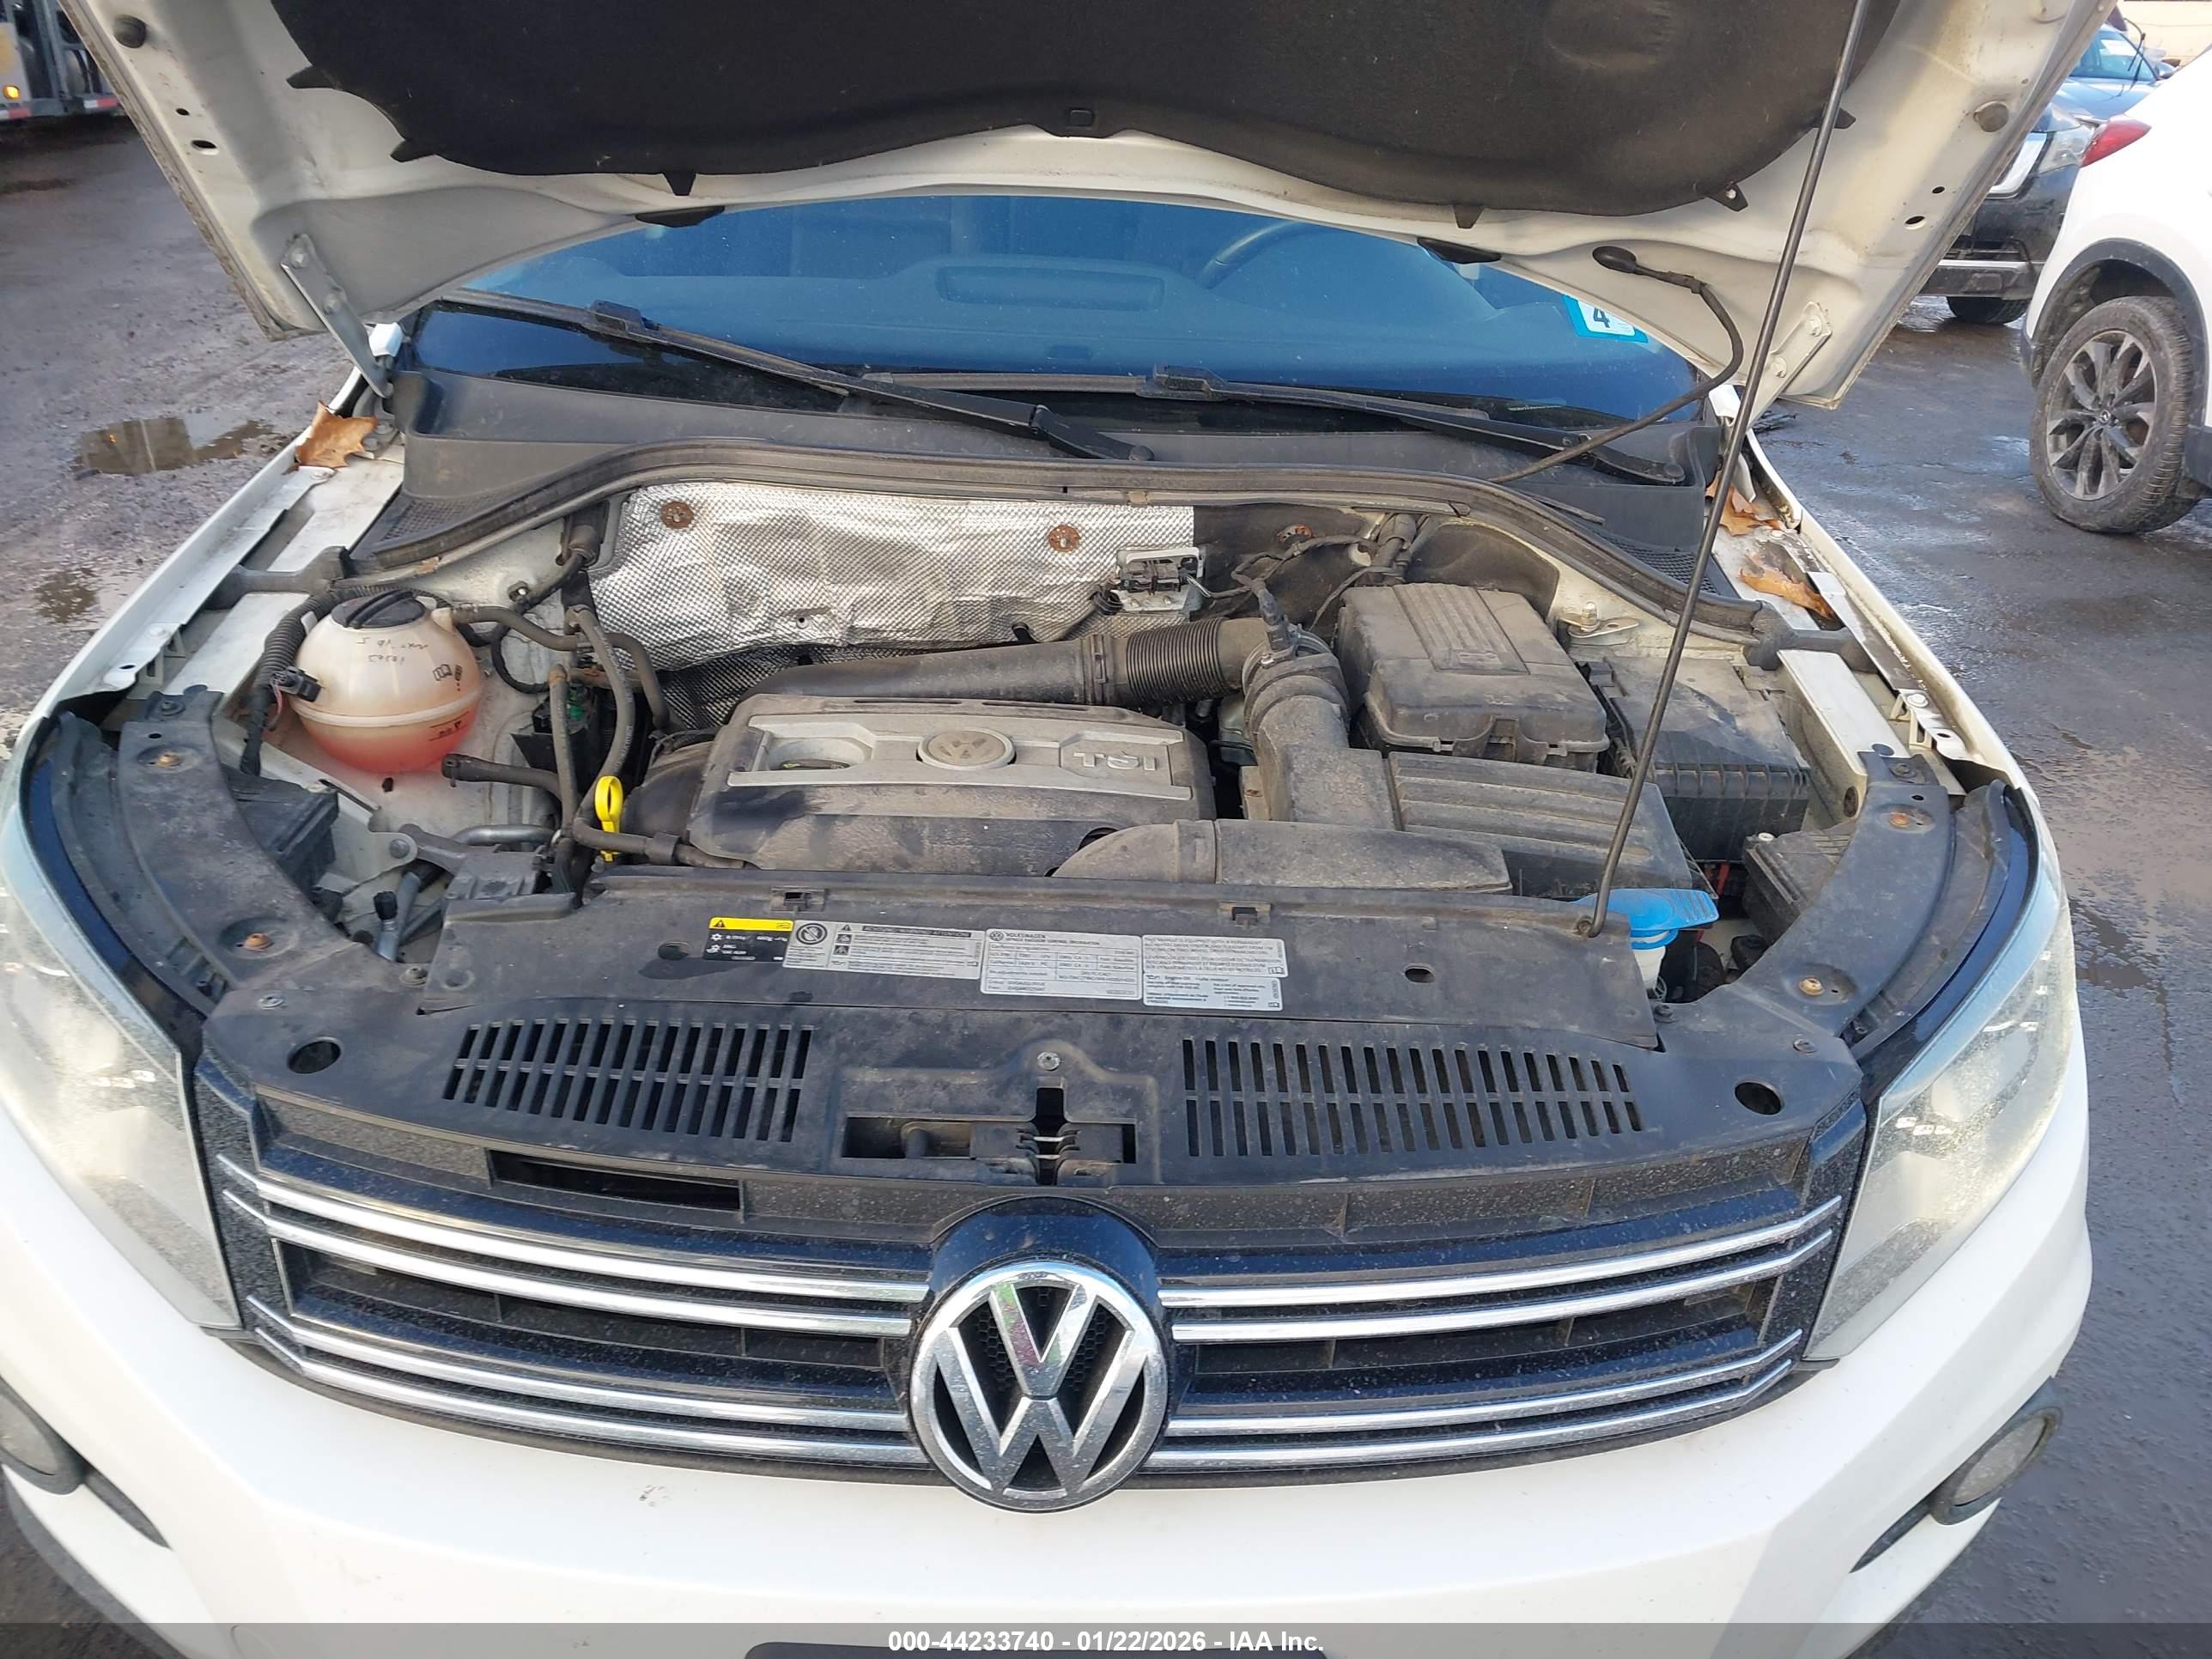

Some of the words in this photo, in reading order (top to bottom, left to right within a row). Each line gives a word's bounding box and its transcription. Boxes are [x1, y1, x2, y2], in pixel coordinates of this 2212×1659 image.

[1593, 307, 1611, 328] 4
[1073, 752, 1157, 771] TSI
[921, 1271, 1157, 1507] VW
